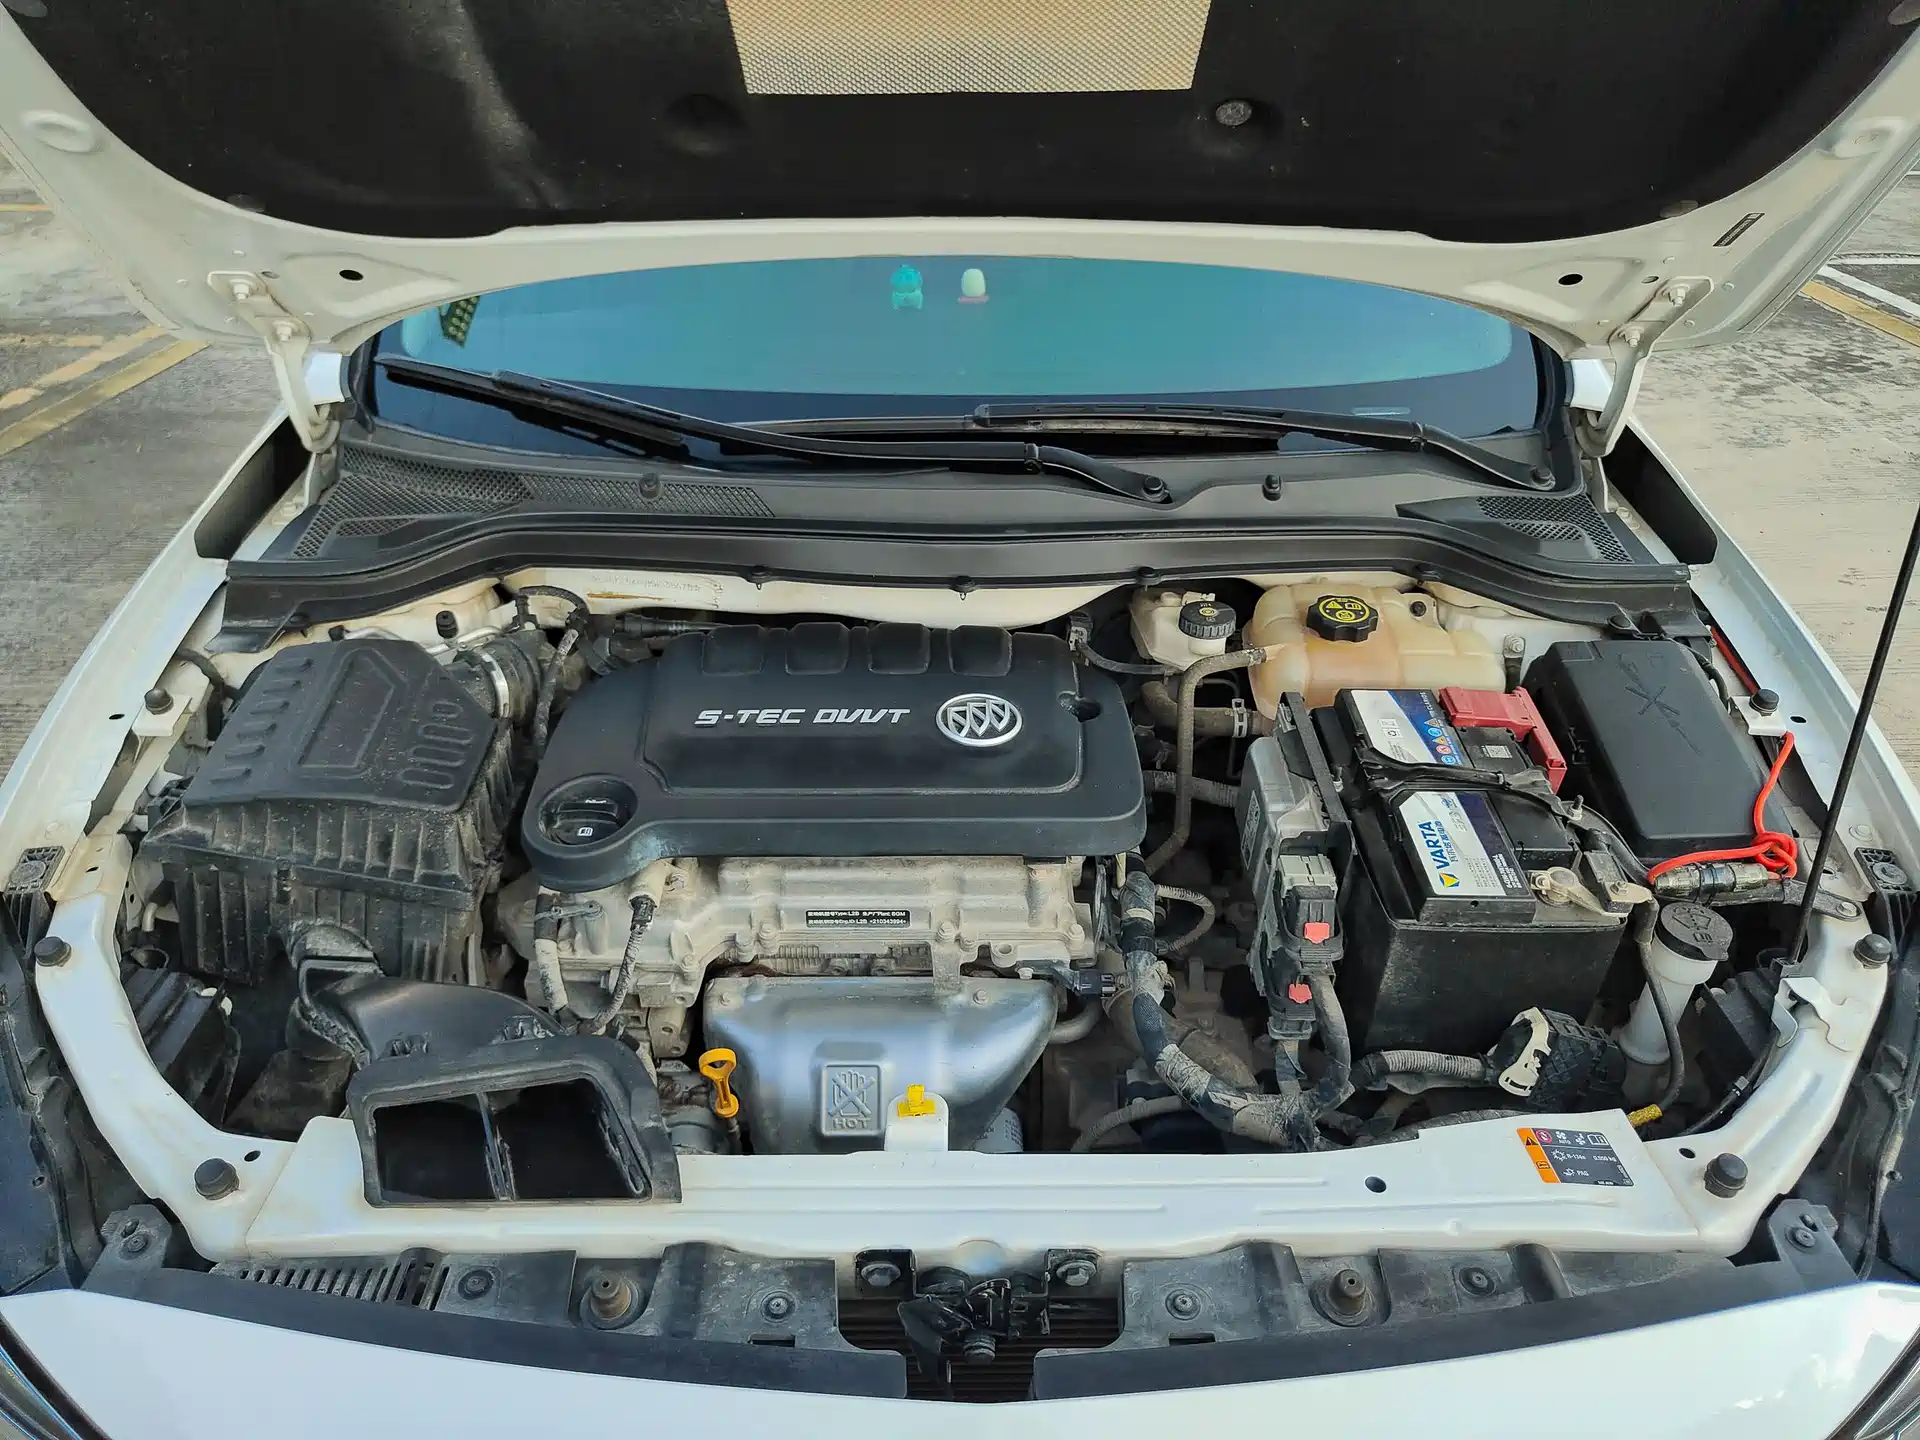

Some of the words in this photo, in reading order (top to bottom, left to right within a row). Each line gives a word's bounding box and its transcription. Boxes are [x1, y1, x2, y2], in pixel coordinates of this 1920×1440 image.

[694, 708, 806, 726] S-TEC
[812, 708, 911, 725] DVVT
[1418, 821, 1450, 869] VARTA
[833, 1118, 869, 1129] HOT
